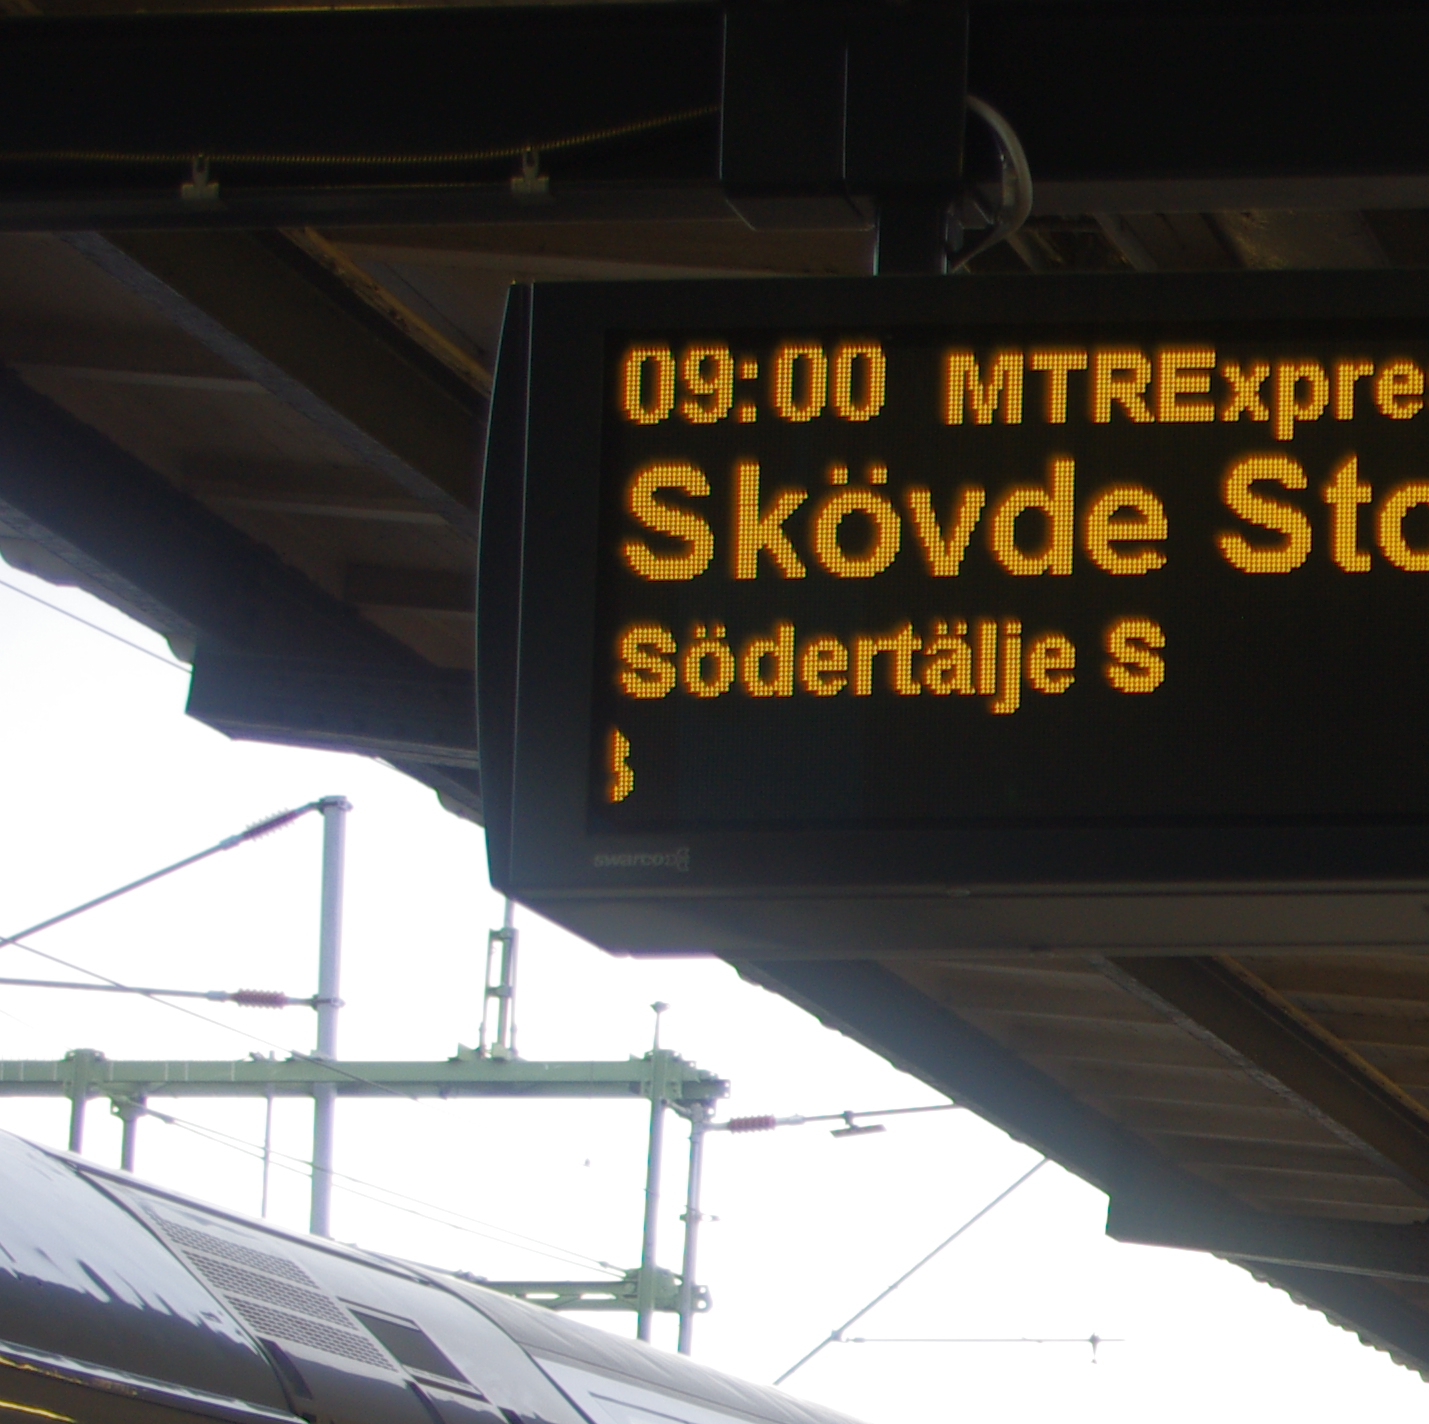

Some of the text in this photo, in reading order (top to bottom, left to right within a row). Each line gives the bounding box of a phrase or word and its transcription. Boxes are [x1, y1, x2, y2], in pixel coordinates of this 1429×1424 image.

[621, 344, 886, 425] 09:00
[622, 457, 1169, 581] Skövde
[617, 618, 1166, 715] Södertälje S
